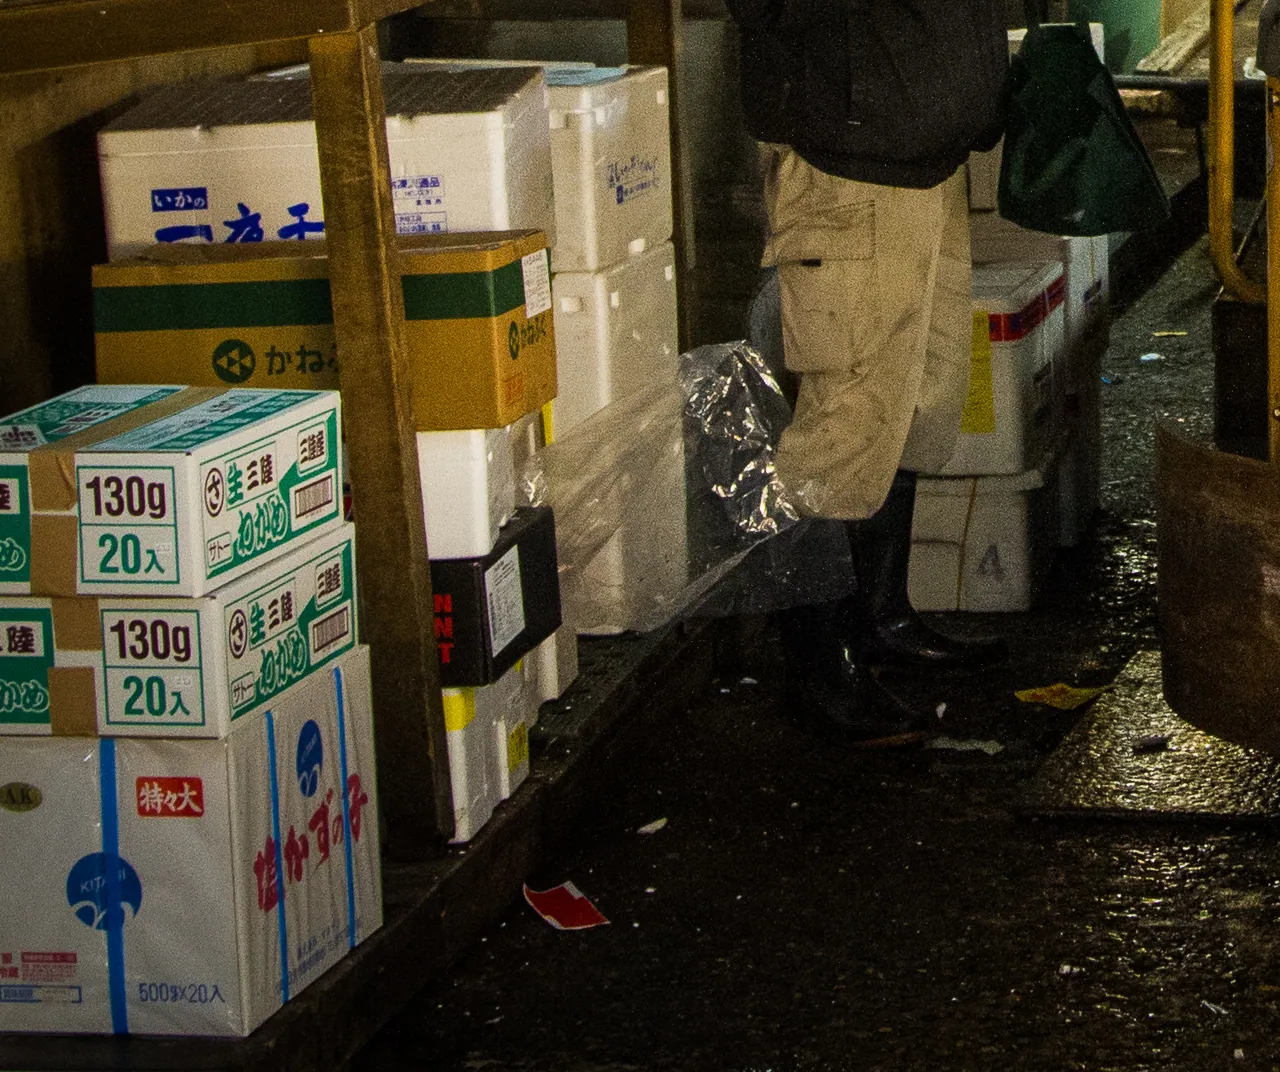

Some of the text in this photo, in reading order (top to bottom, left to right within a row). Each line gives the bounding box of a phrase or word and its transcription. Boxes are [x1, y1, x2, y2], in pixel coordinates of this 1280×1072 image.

[154, 191, 206, 208] いかの
[85, 476, 167, 519] 130g
[238, 494, 288, 556] わかめ
[98, 533, 165, 574] 20入
[209, 540, 231, 561] サトー
[110, 619, 192, 662] 130g
[260, 630, 307, 695] わかめ
[123, 675, 190, 716] 20入
[233, 680, 253, 703] サトー
[139, 781, 203, 814] 特々大
